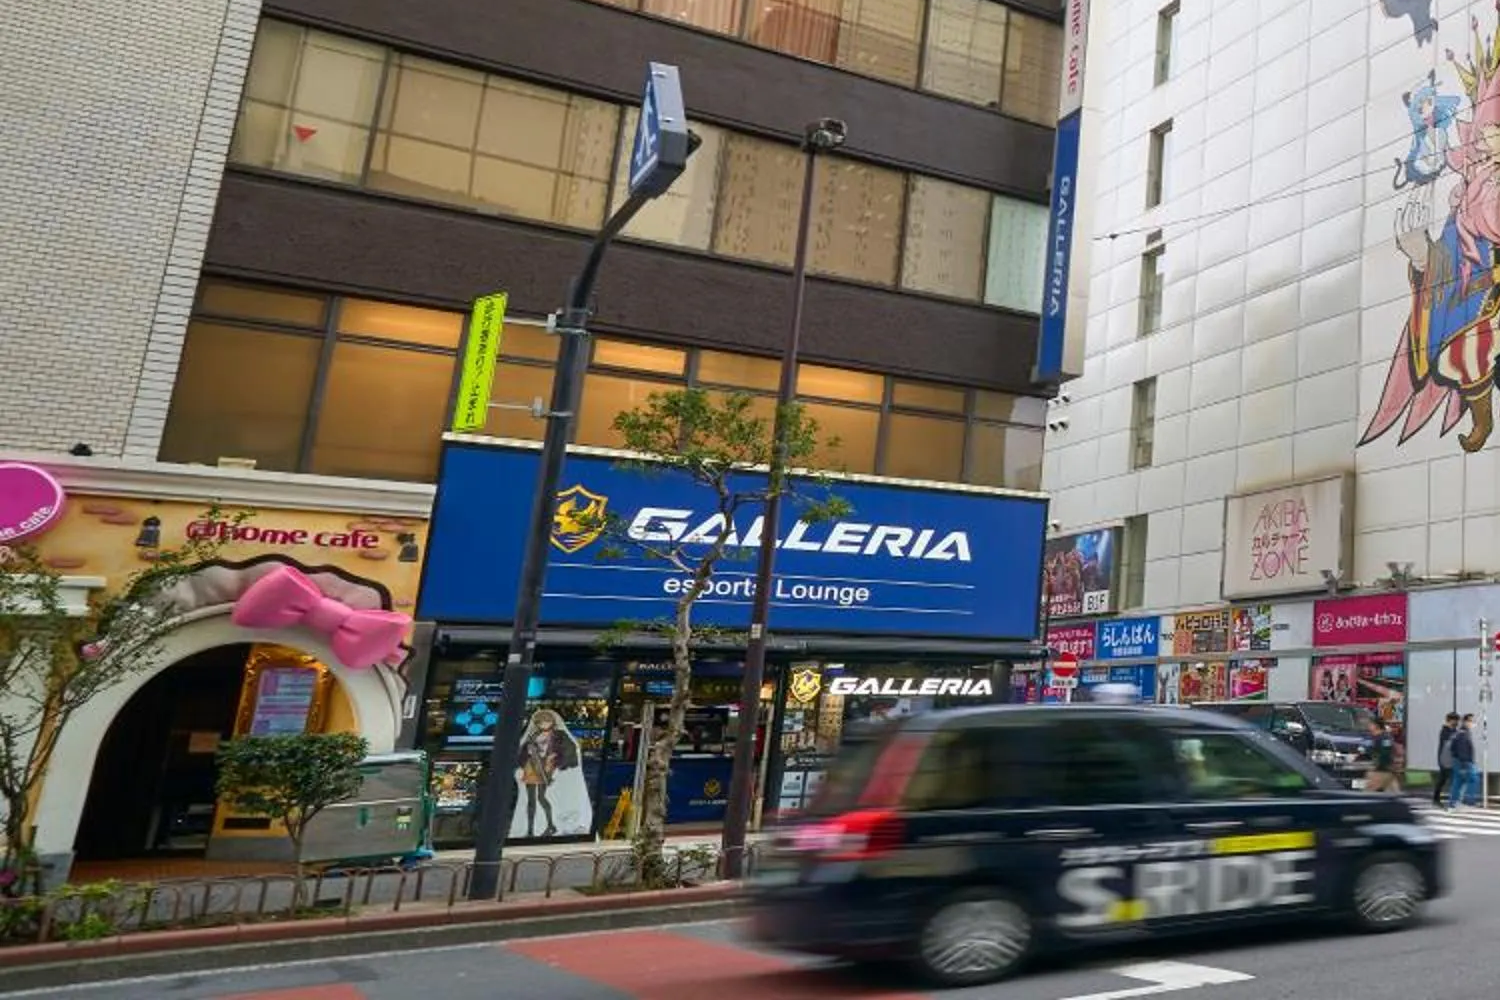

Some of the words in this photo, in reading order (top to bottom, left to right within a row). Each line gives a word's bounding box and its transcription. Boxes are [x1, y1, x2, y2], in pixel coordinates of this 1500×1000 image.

[1050, 175, 1072, 317] GALLERIA
[1252, 498, 1310, 534] AKIBA
[186, 520, 309, 546] @home
[314, 529, 380, 549] cafe
[626, 507, 972, 562] GALLERIA
[1249, 546, 1309, 581] ZONE
[775, 579, 870, 605] Lounge
[1102, 624, 1155, 648] らしんばん
[829, 677, 993, 696] GALLERIA
